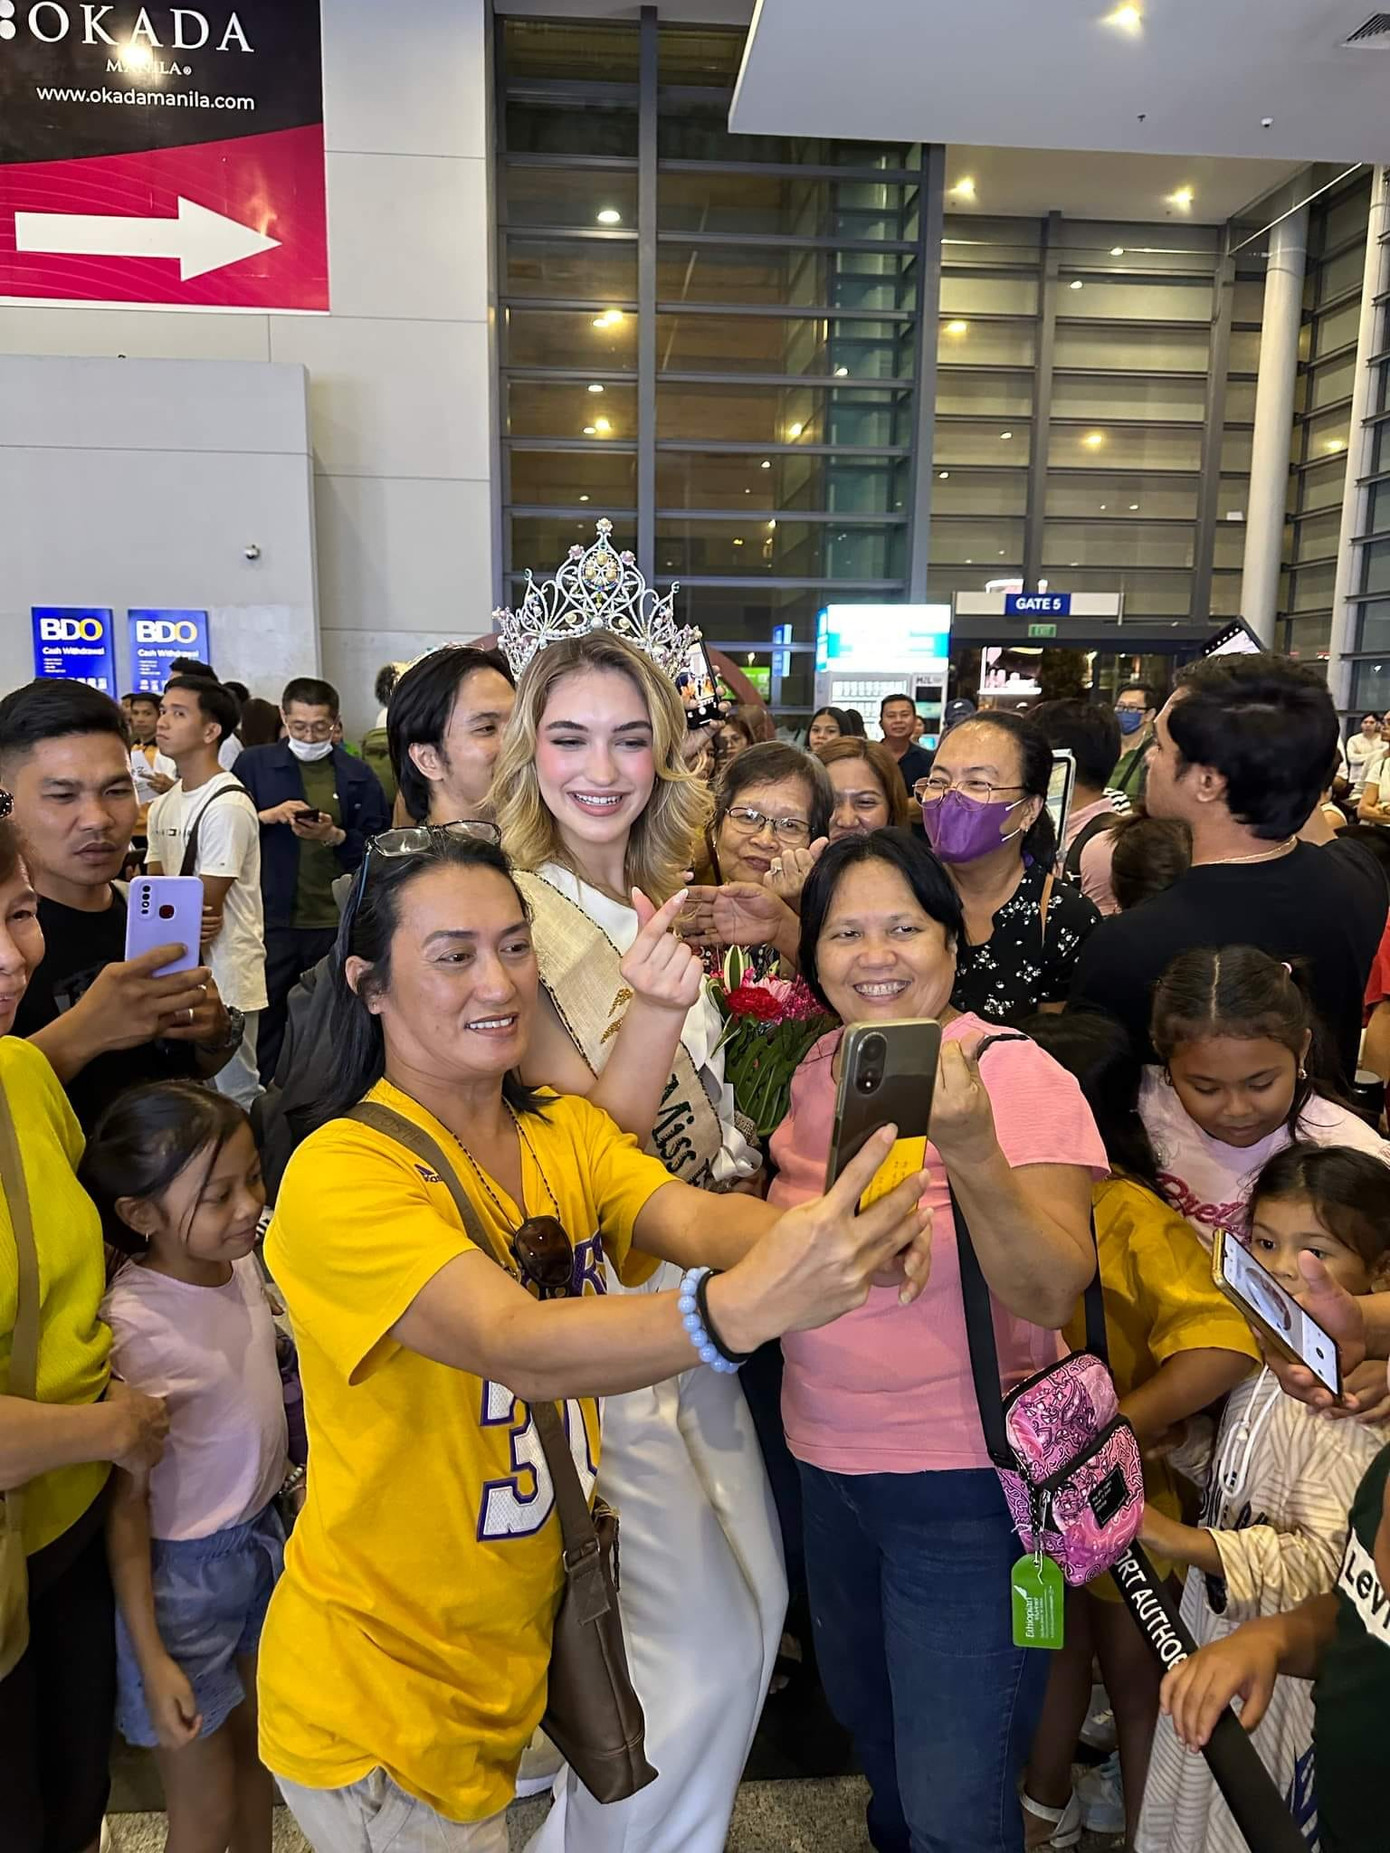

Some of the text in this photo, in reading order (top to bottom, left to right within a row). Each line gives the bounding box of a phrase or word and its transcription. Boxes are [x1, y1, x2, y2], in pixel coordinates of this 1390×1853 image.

[28, 1, 254, 52] OKADA
[36, 87, 255, 110] www.okadamanila.com
[1015, 597, 1062, 610] GATE 5
[39, 618, 103, 642] BDO
[135, 620, 198, 644] BDO
